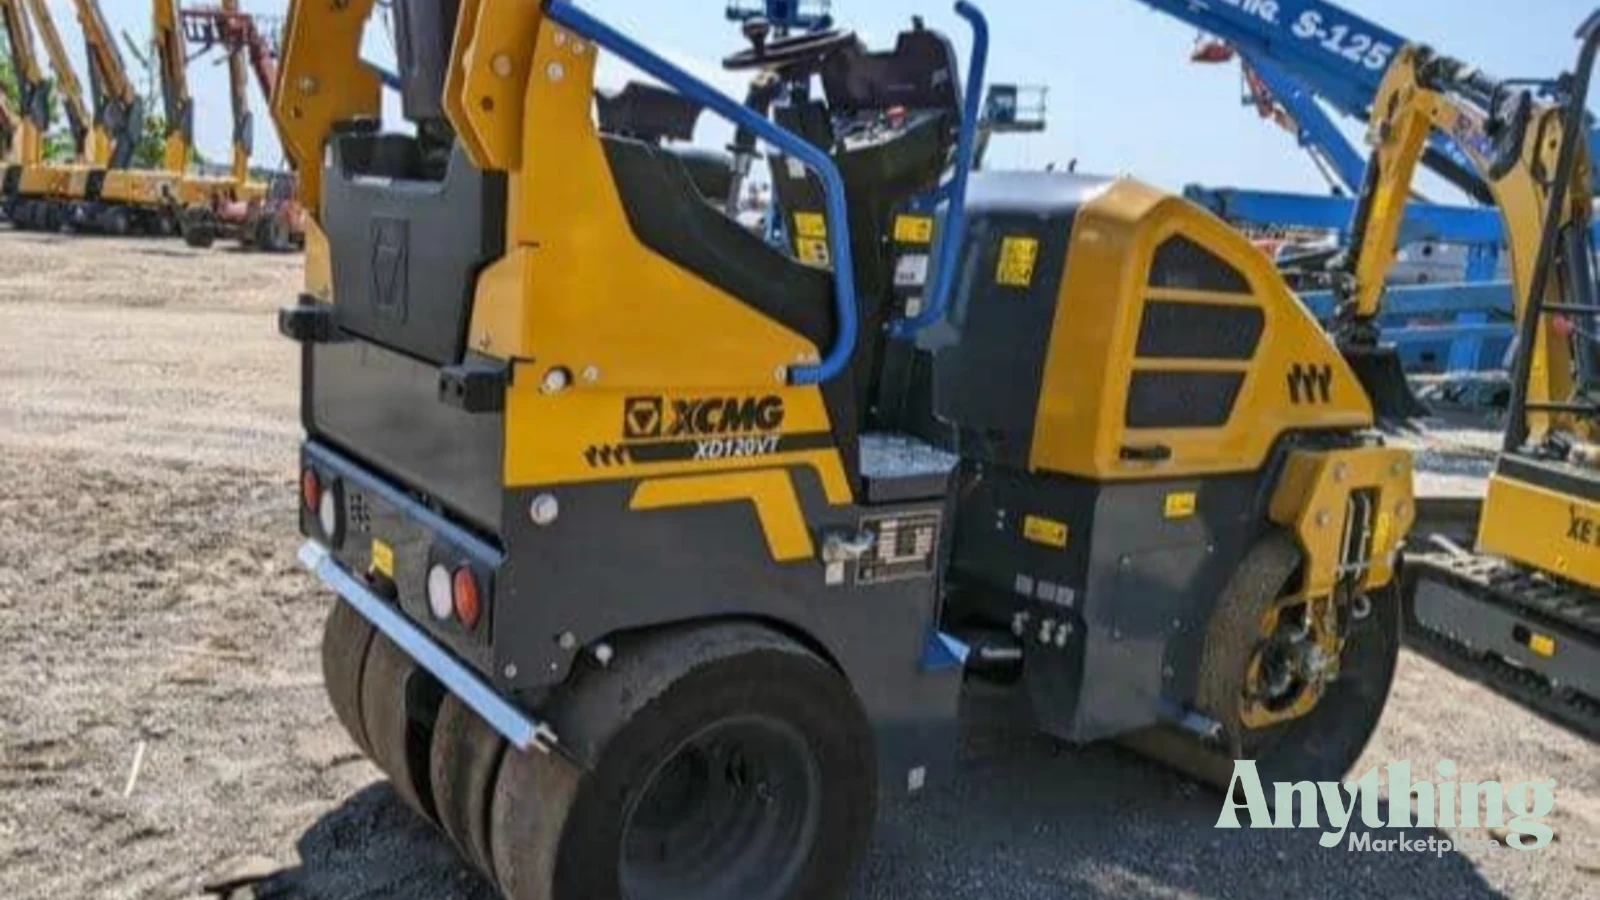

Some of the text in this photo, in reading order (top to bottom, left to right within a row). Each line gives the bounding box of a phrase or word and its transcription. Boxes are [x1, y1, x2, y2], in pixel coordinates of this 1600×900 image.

[1291, 10, 1393, 70] S-125
[665, 396, 784, 435] XCMG
[695, 436, 780, 460] XD120VT
